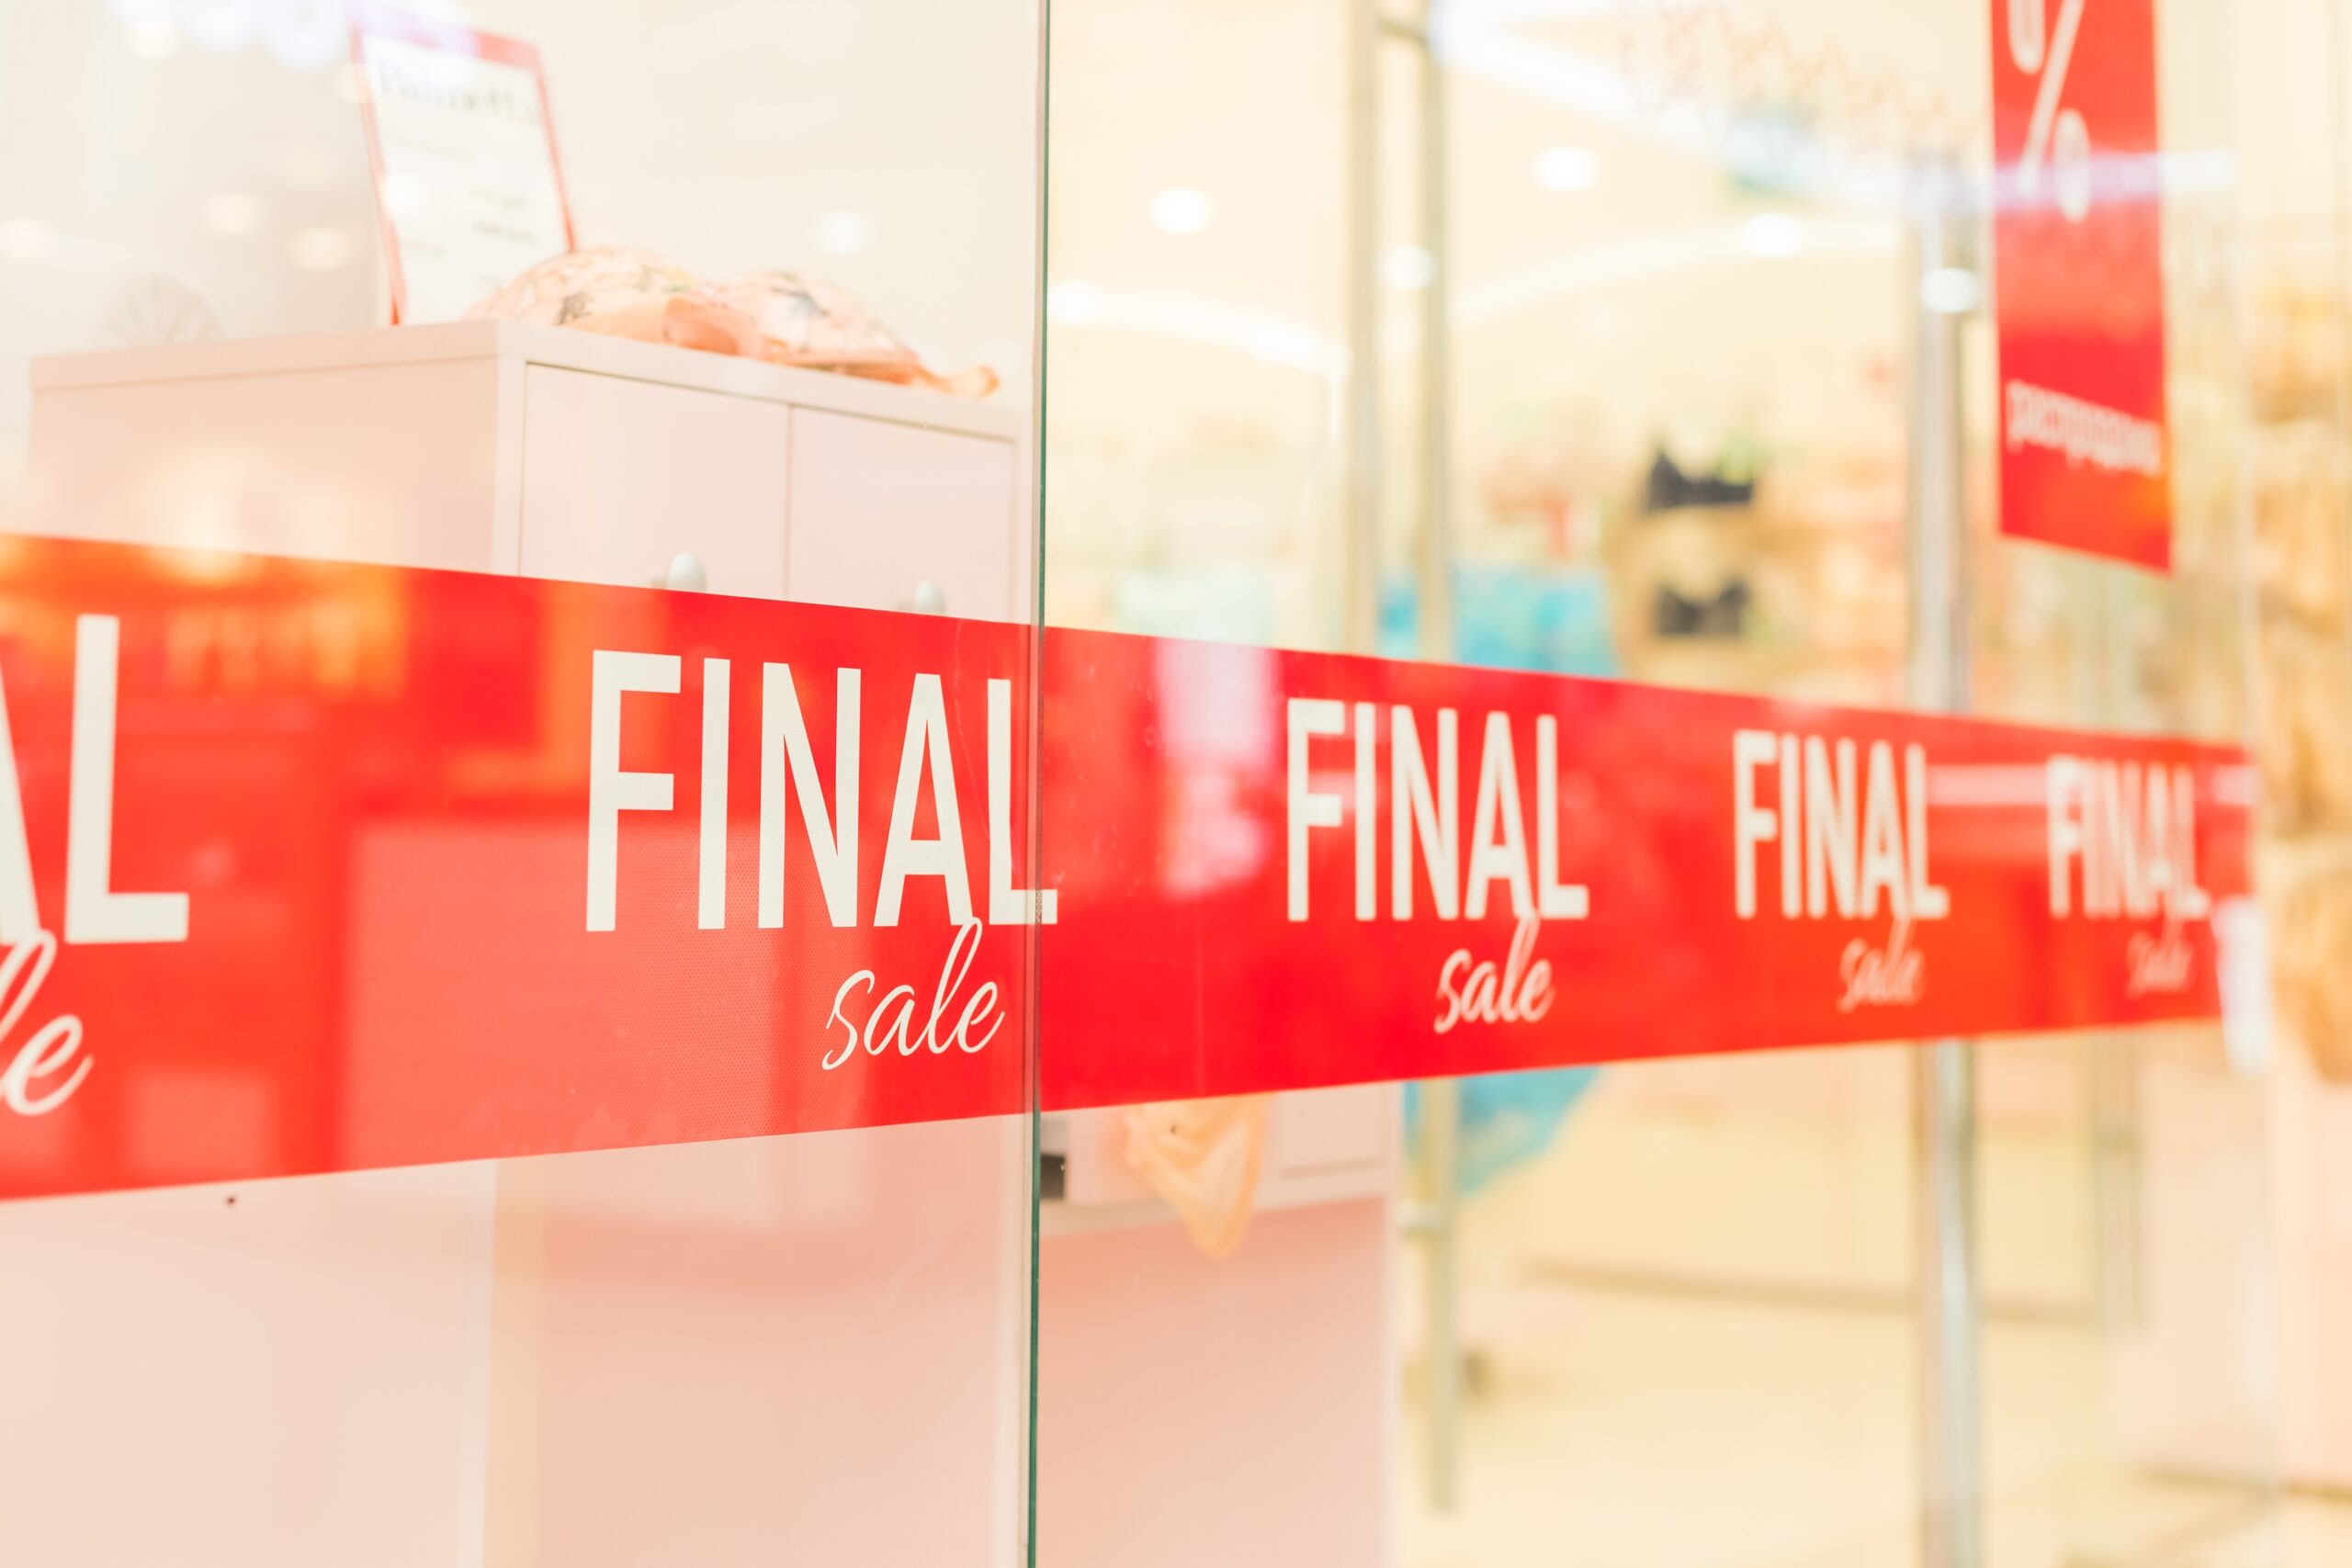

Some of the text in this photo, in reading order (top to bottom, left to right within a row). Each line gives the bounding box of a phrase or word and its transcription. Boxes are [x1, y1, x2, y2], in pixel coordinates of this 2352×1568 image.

[586, 649, 1057, 931] FINAL
[1287, 698, 1589, 921] FINAL
[1734, 729, 1950, 919] FINAL
[2047, 753, 2211, 919] FINAL
[821, 917, 1005, 1071] sale
[1433, 908, 1555, 1034] sale
